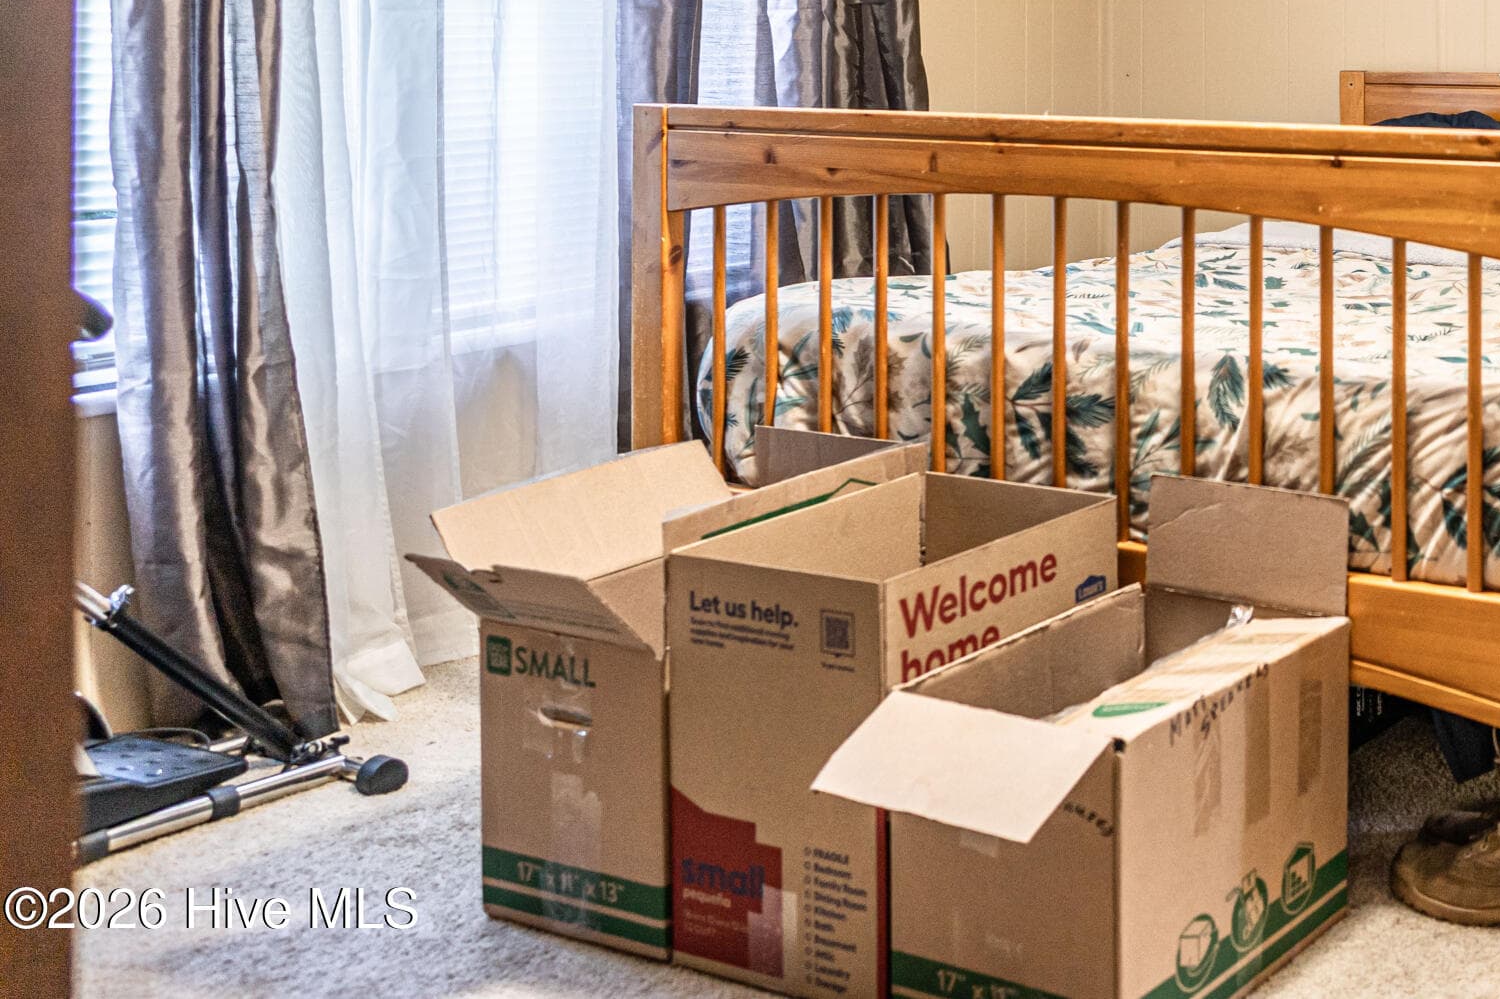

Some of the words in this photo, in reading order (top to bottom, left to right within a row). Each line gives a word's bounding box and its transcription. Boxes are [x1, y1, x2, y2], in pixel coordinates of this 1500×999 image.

[689, 590, 721, 615] Let
[724, 600, 747, 619] us
[751, 600, 799, 630] help.
[899, 553, 1058, 639] Welcome
[514, 646, 597, 688] SMALL
[681, 857, 766, 899] small
